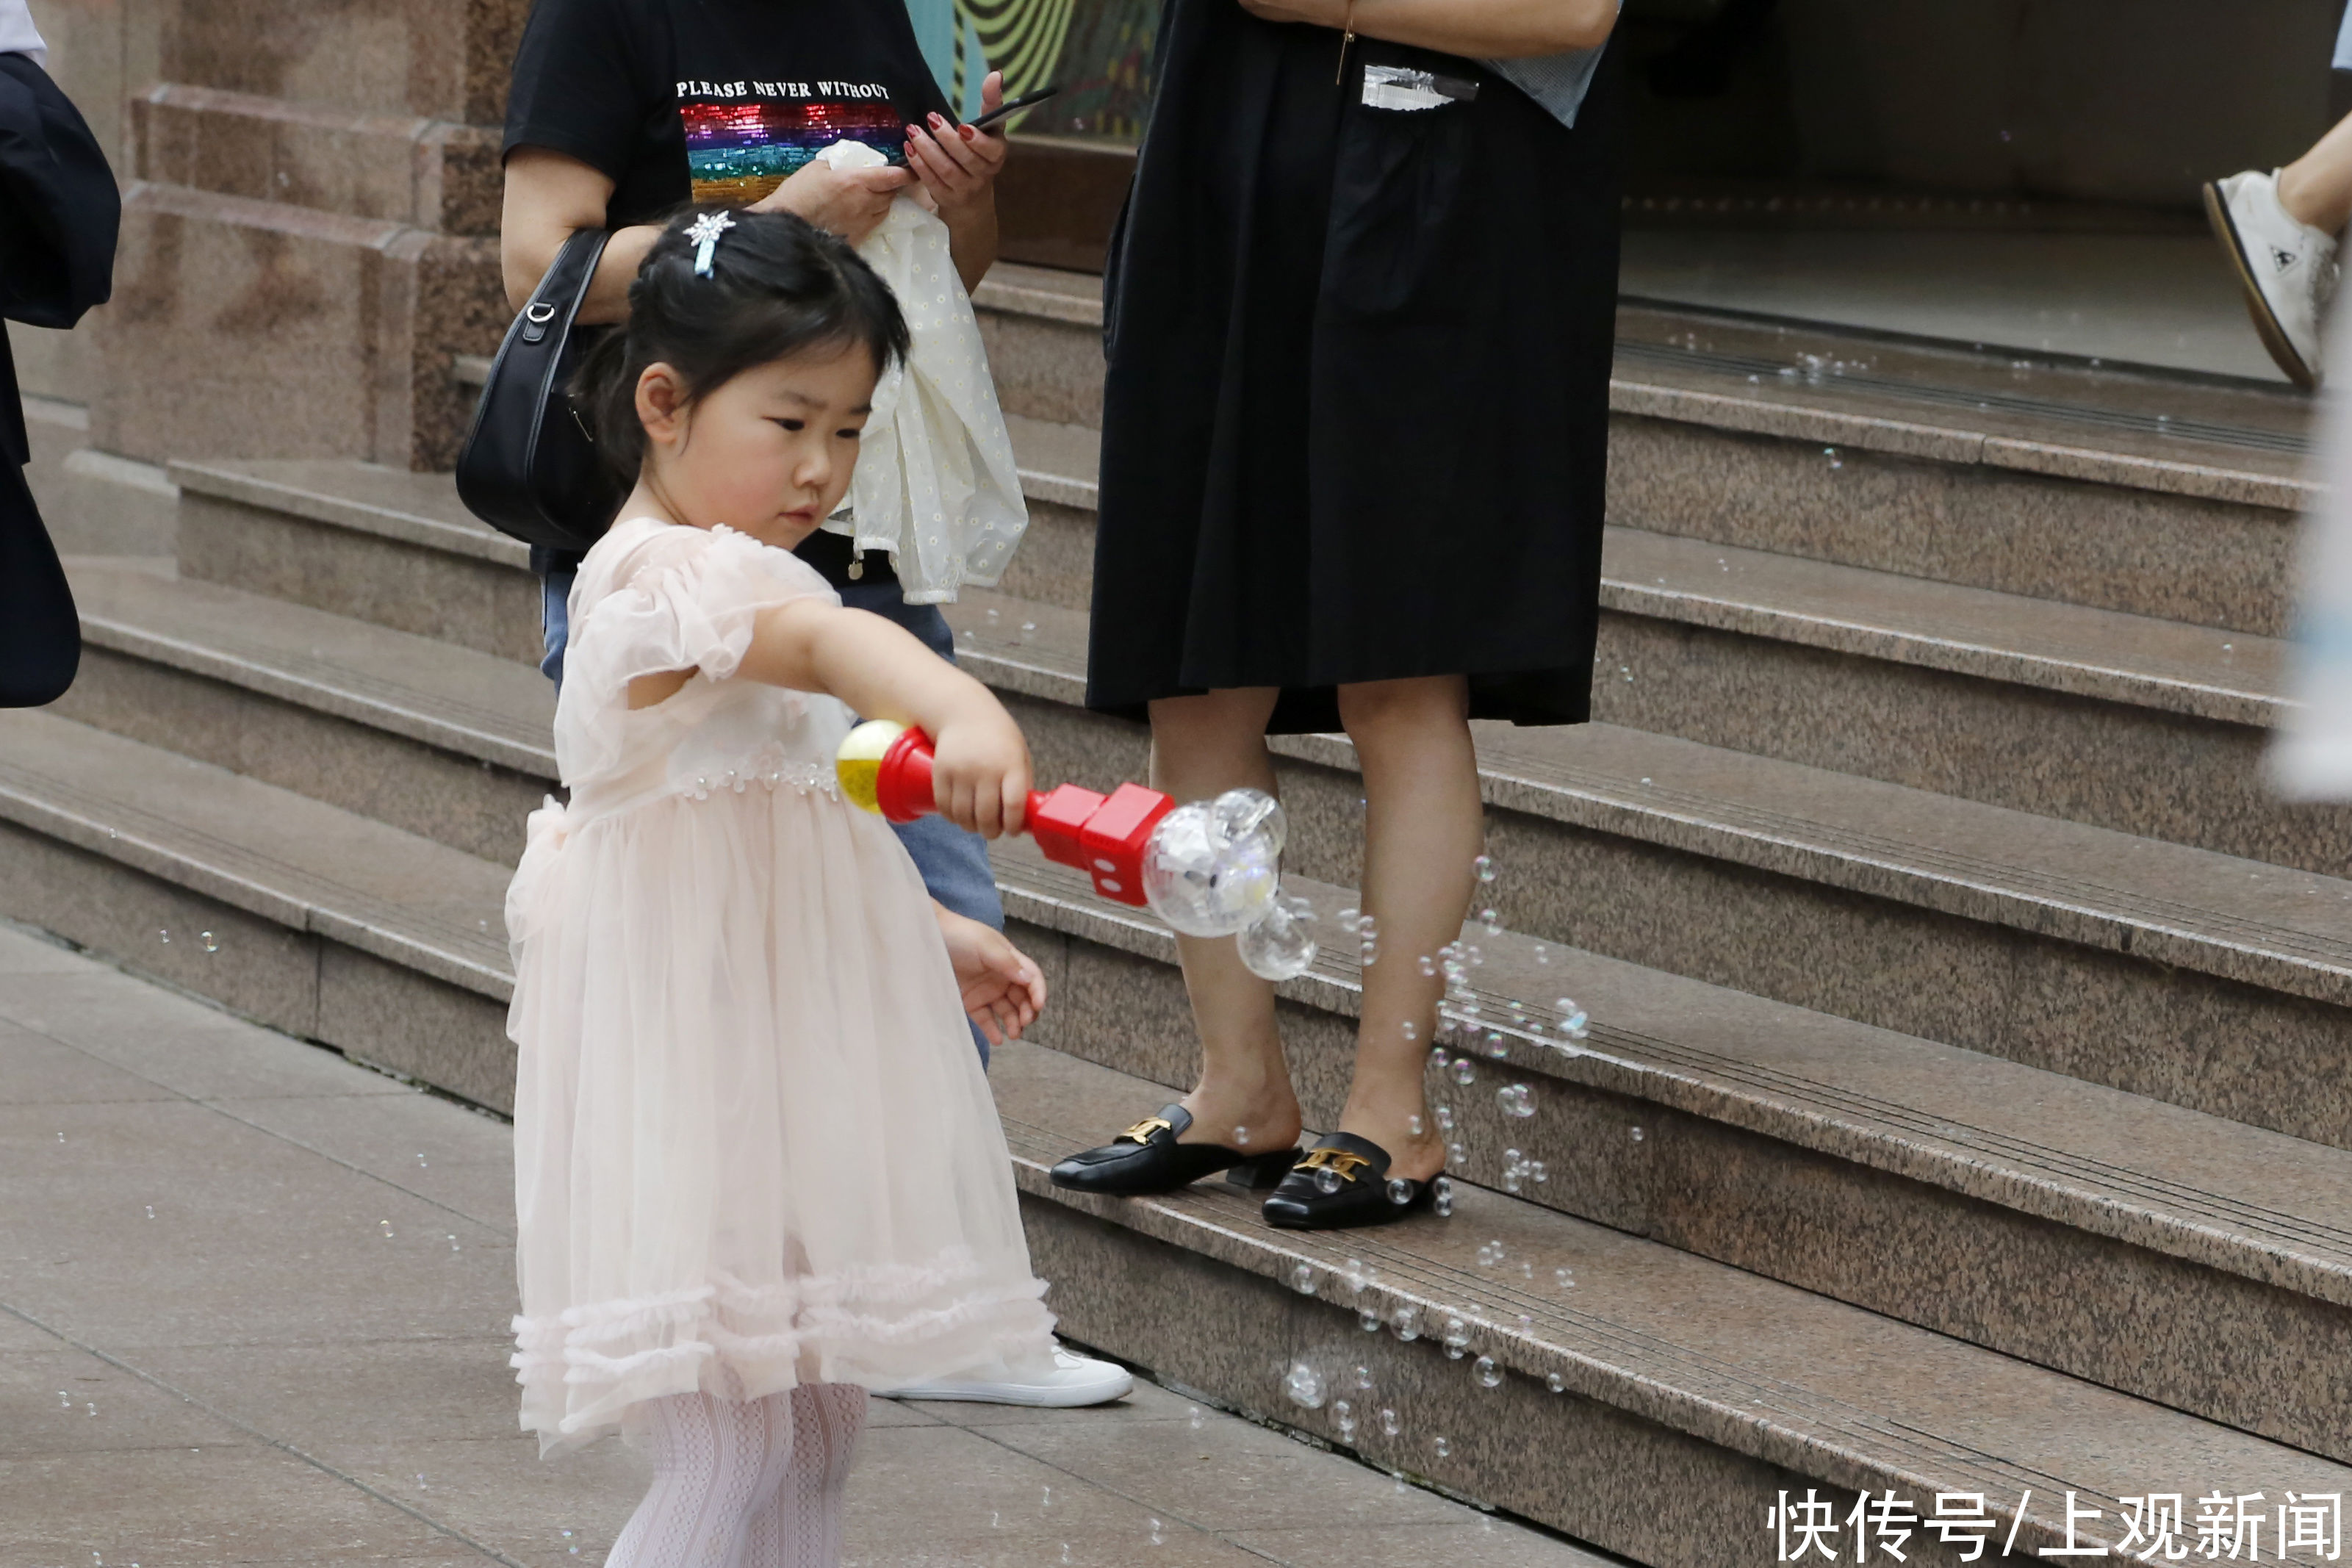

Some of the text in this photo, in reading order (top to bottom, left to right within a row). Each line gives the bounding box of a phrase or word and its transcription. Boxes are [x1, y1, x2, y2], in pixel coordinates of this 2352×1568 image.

[677, 81, 889, 99] PLEASE NEVER WITHOUT
